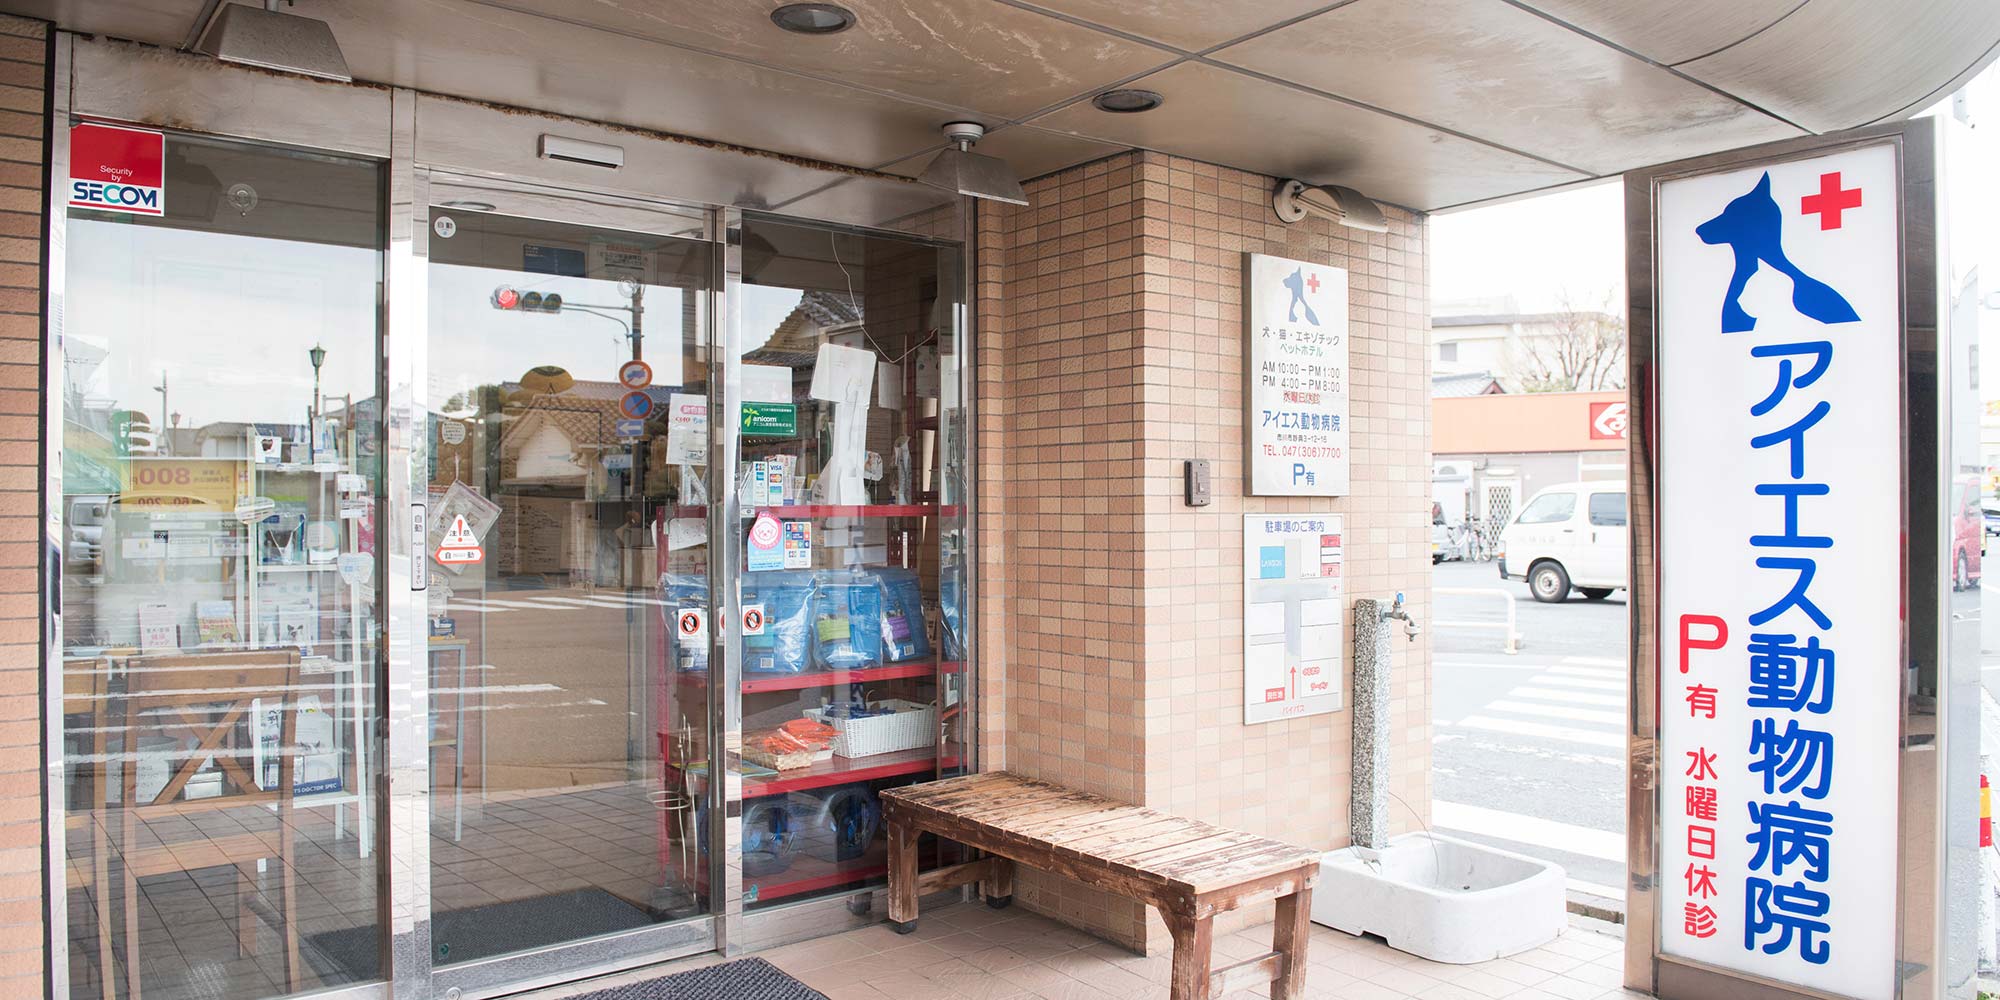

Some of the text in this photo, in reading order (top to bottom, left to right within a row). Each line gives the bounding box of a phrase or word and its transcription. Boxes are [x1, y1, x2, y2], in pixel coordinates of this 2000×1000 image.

[100, 164, 133, 177] Security
[111, 174, 122, 183] by
[73, 181, 158, 208] SECOM
[1262, 360, 1276, 373] AM
[1278, 362, 1300, 375] 10:00
[1308, 365, 1322, 377] PM
[1323, 367, 1341, 379] 1:00
[1262, 375, 1276, 388] PM
[1281, 377, 1300, 390] 4:00
[1308, 379, 1322, 391] PM
[1323, 380, 1341, 393] 8:00
[752, 415, 777, 423] anicom
[1262, 410, 1341, 432] アイエス動物病院
[1293, 463, 1316, 486] P有
[1265, 520, 1326, 533] 駐車場のご案内
[1745, 340, 1834, 965] アイエス動物病院
[1679, 613, 1730, 940] P有 水曜日休診
